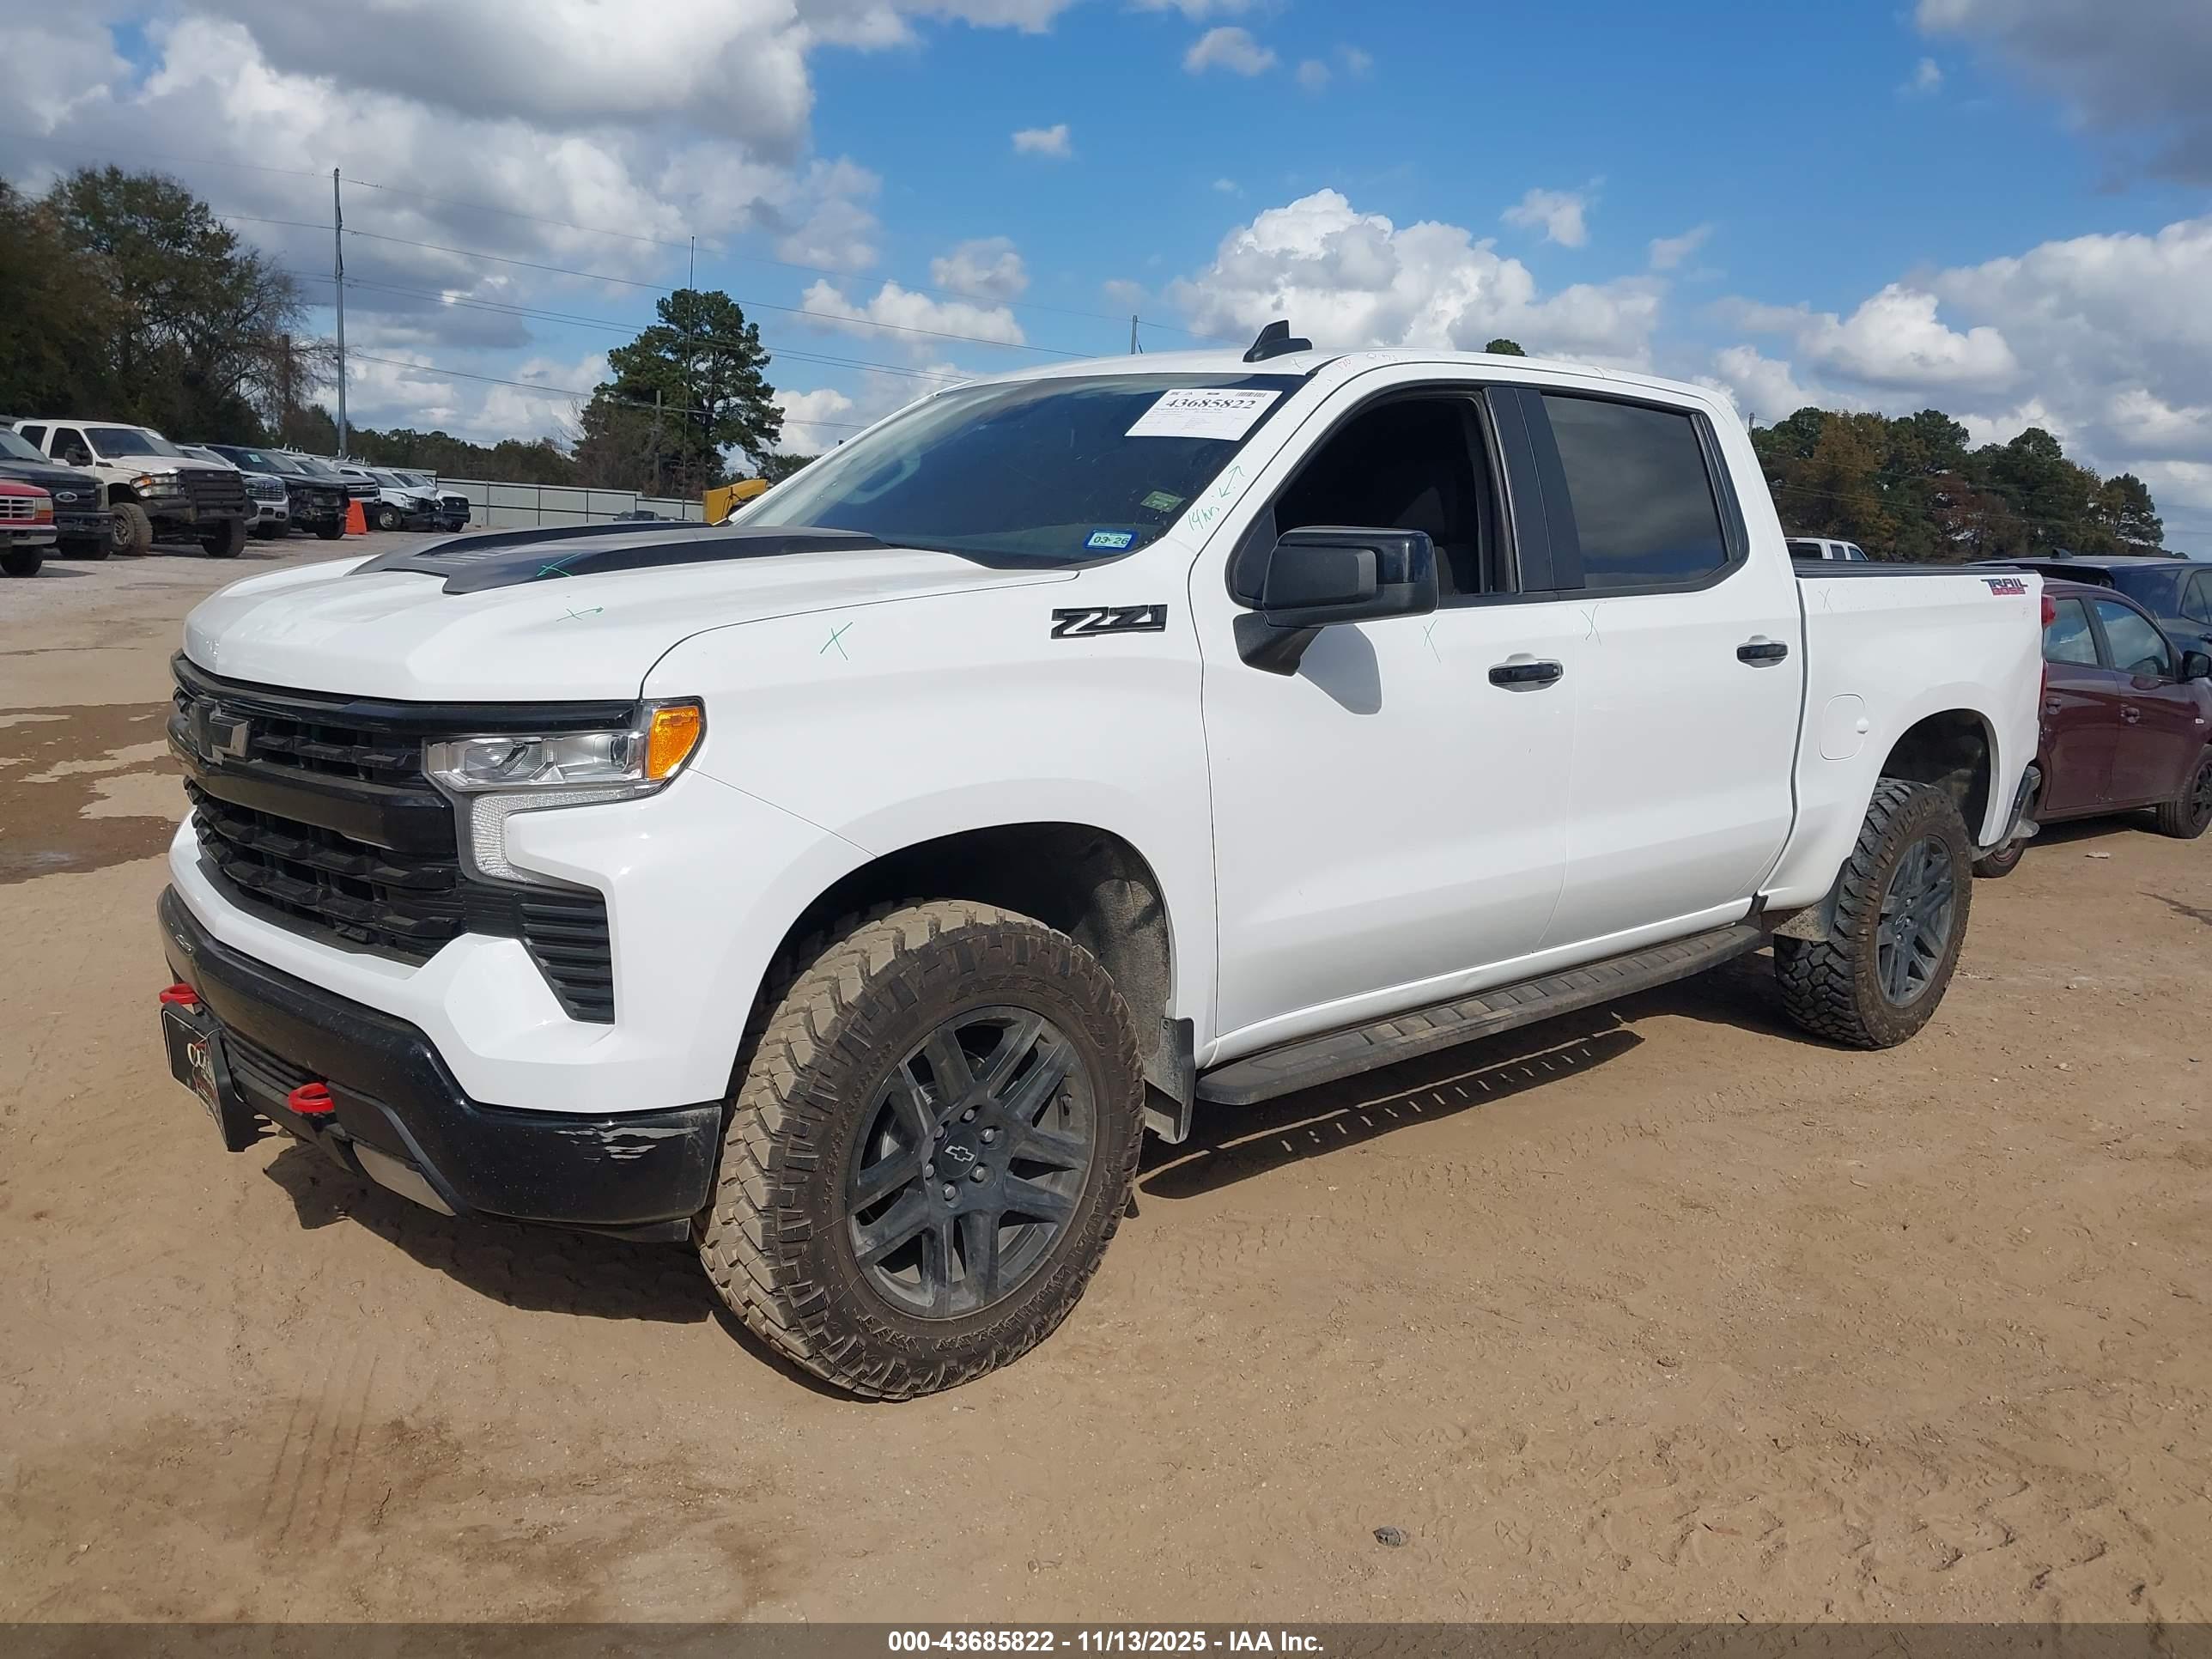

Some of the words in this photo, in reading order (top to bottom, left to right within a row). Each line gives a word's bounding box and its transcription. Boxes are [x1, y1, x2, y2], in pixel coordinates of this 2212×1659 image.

[1165, 398, 1256, 410] 43685822
[1093, 535, 1108, 544] 03
[1112, 537, 1128, 545] 26
[1980, 578, 2028, 588] TRAIL
[1050, 604, 1168, 640] Z71
